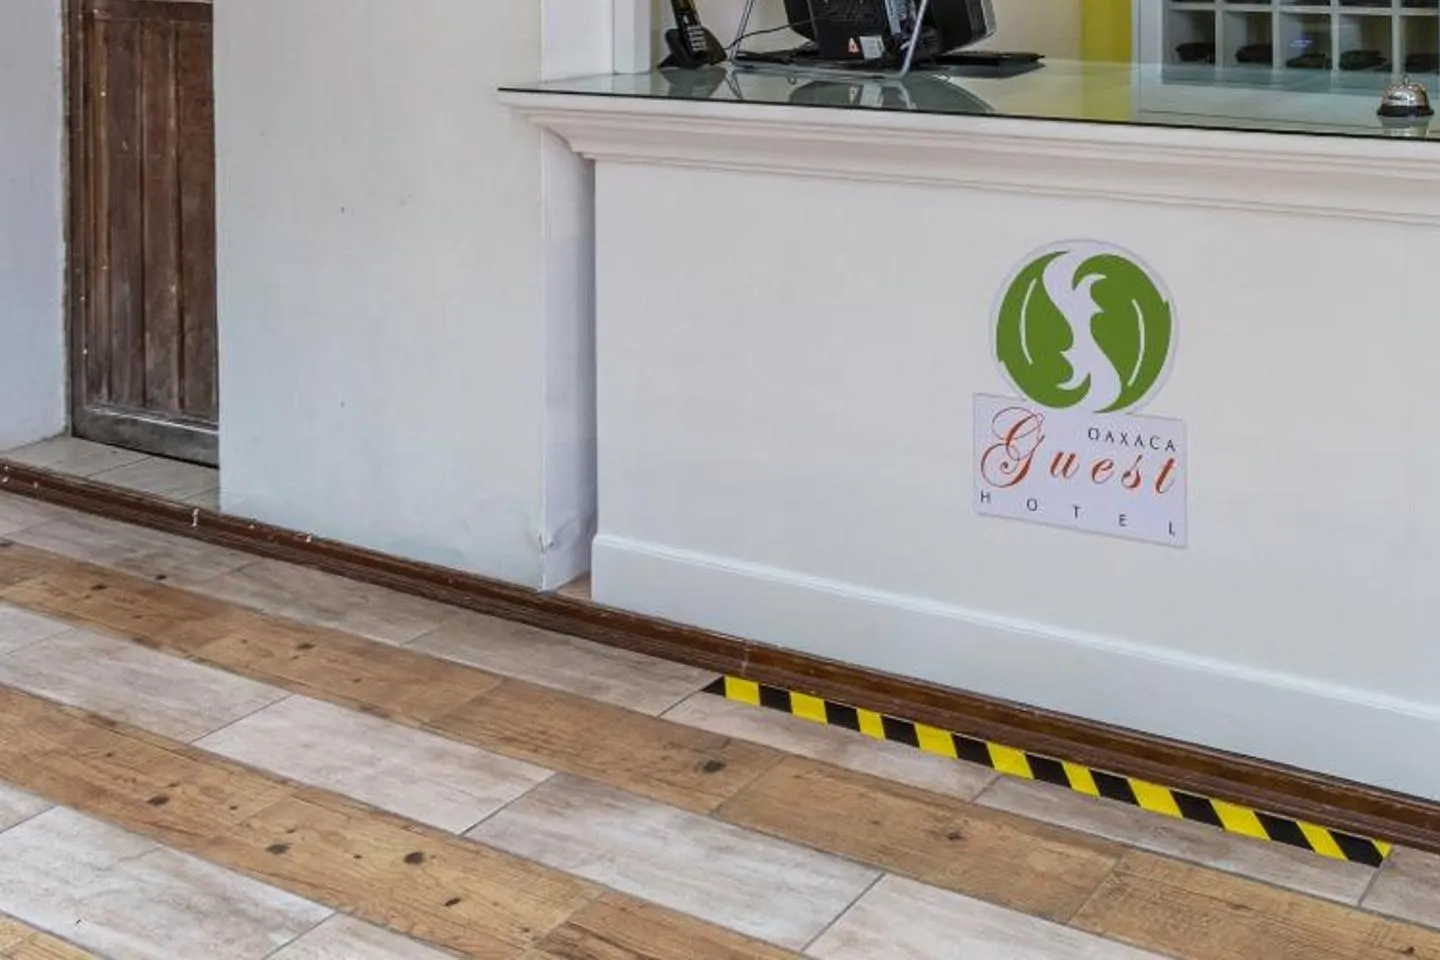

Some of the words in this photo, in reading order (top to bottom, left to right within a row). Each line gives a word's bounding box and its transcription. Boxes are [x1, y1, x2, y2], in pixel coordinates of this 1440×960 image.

[980, 406, 1177, 494] Guest
[1088, 427, 1176, 452] OAXACA
[980, 490, 1176, 536] HOTEL
